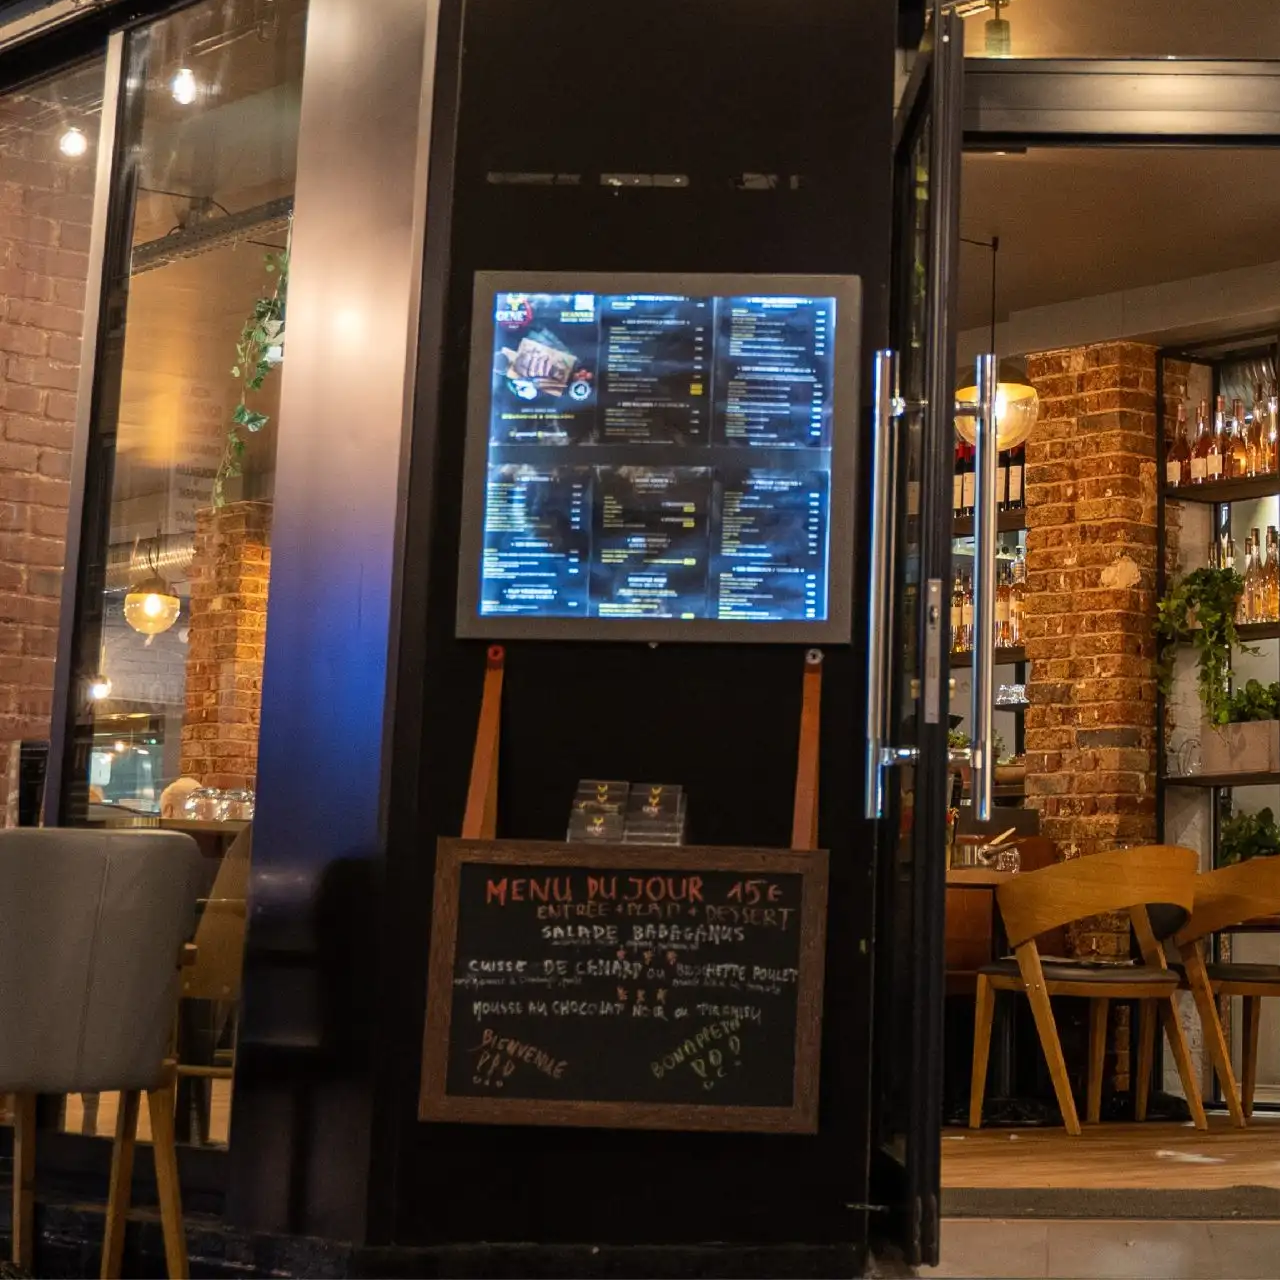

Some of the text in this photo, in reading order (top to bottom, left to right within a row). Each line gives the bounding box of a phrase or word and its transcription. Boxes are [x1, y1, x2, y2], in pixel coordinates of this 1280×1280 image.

[486, 877, 573, 906] MENU
[587, 876, 618, 900] DU
[623, 876, 704, 903] JOUR
[705, 904, 797, 931] DESSERT
[541, 924, 618, 940] SALADE
[468, 959, 528, 973] CUISSE
[543, 959, 570, 975] DE
[752, 965, 800, 983] POULET
[473, 1000, 524, 1022] MOUSSE
[528, 1000, 549, 1017] AU
[551, 1000, 626, 1017] CHOCOLAT
[481, 1028, 569, 1078] BIENVENUE
